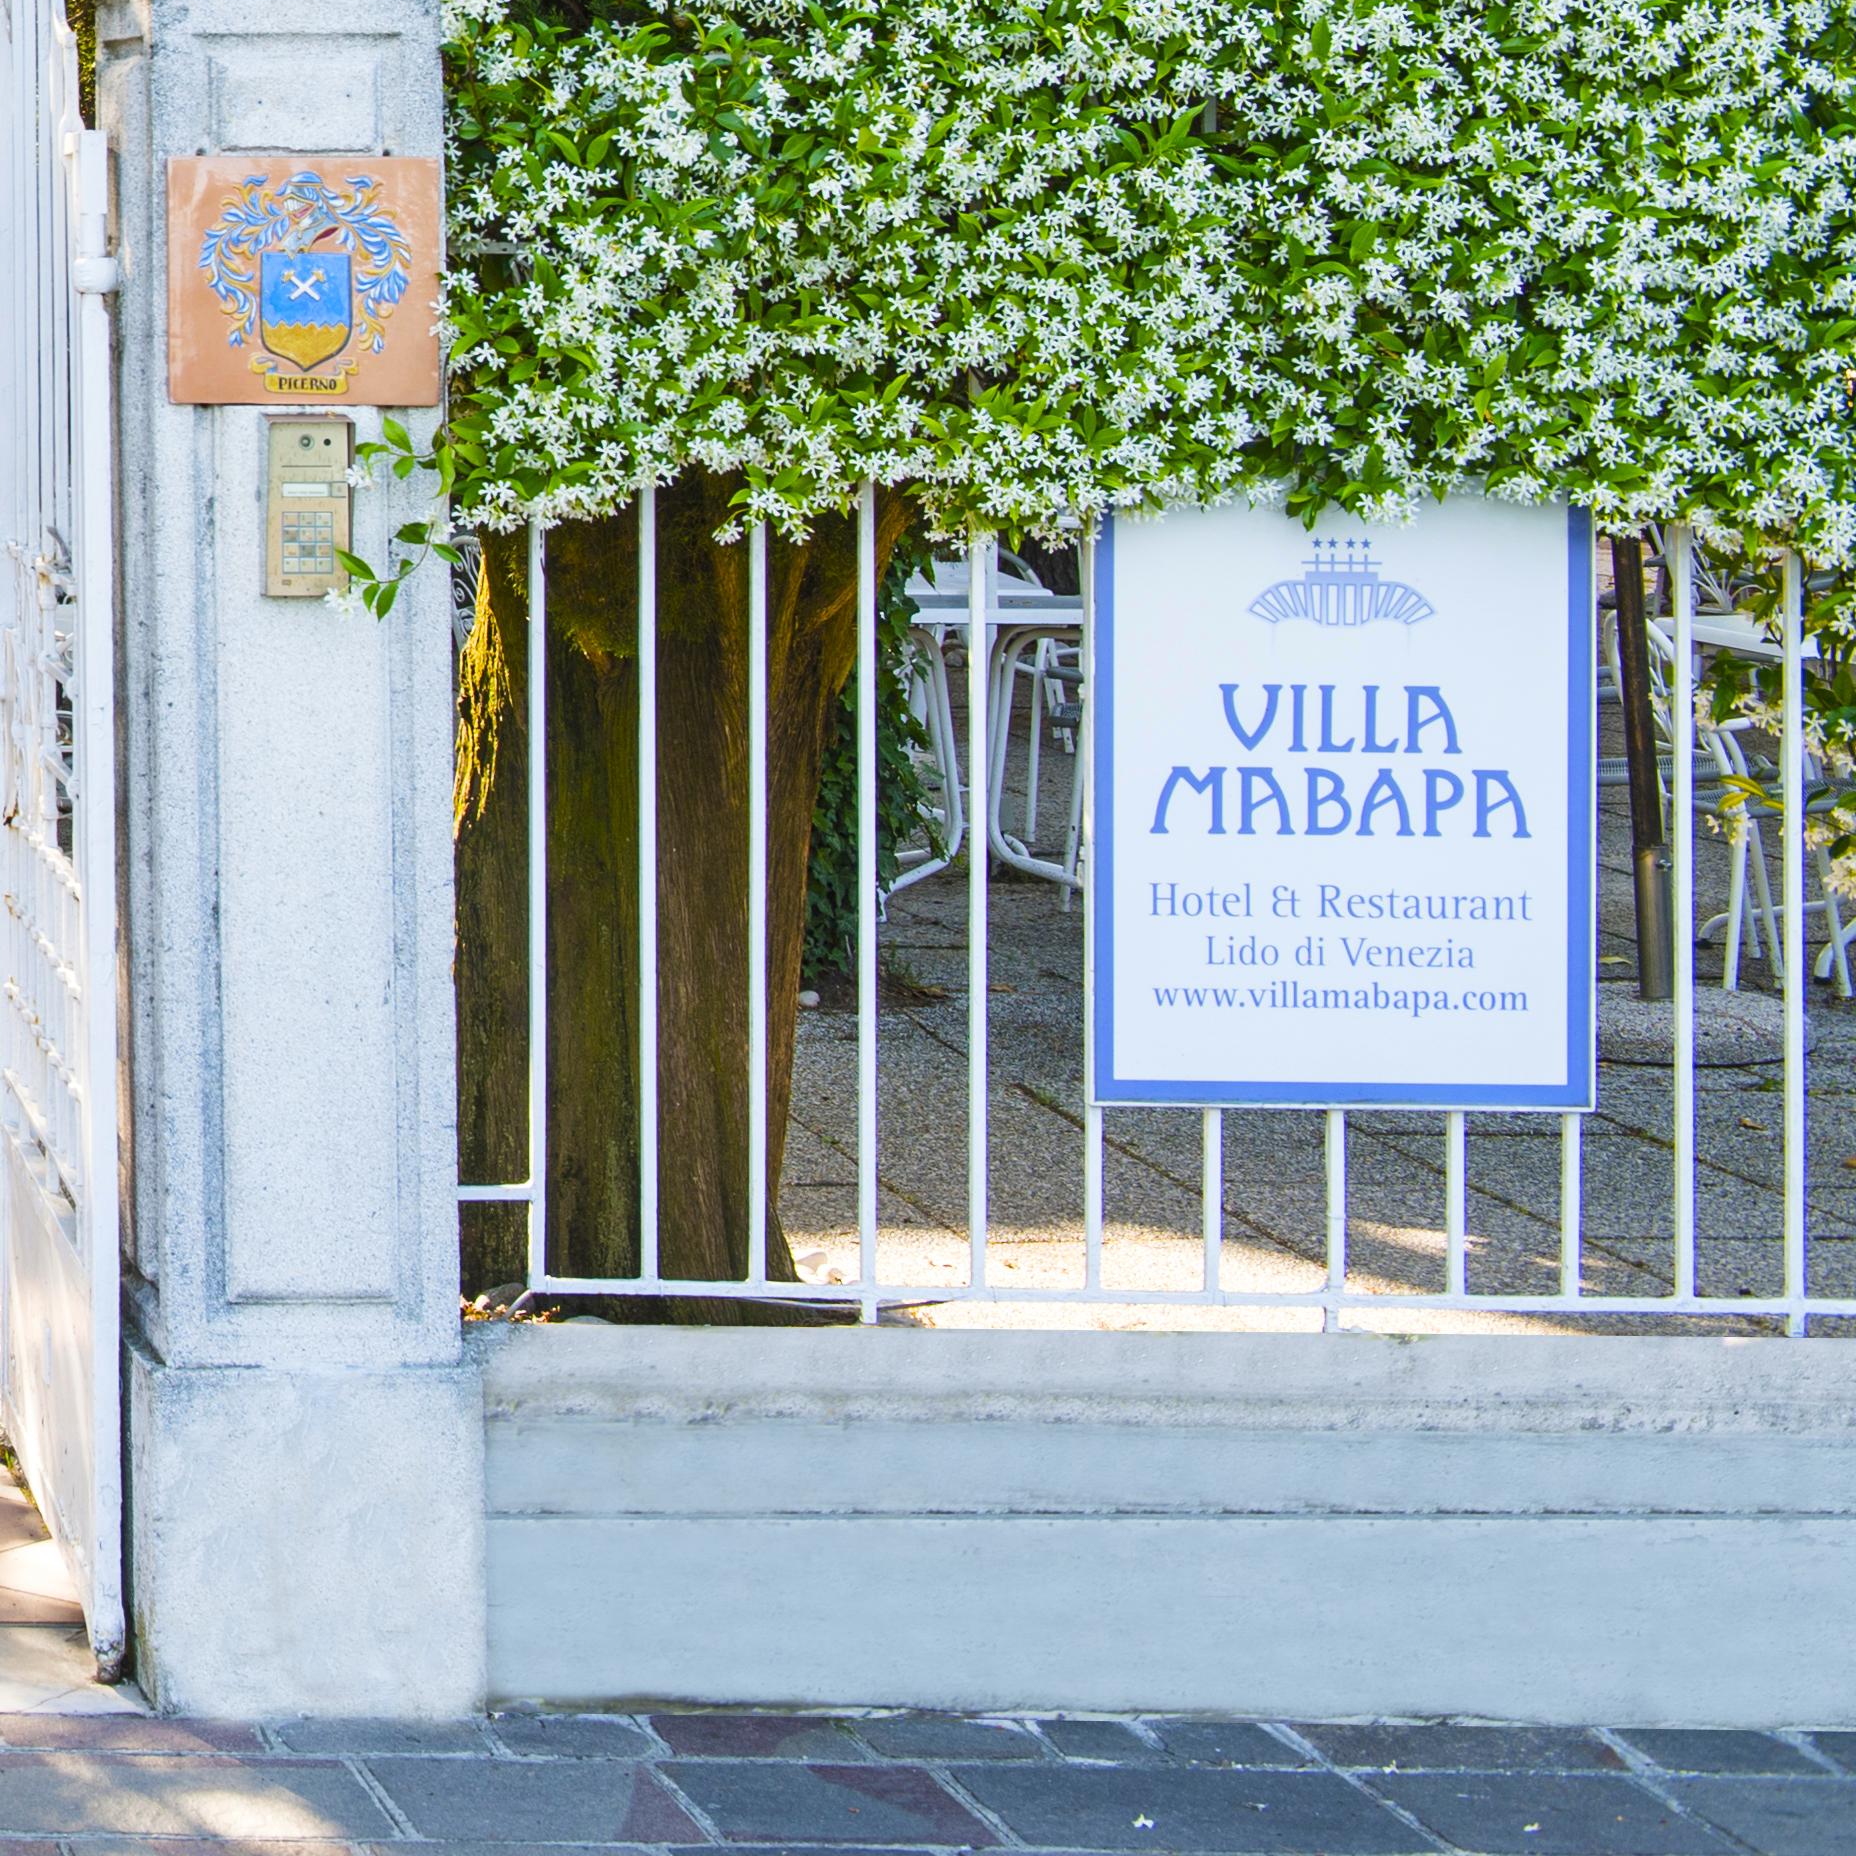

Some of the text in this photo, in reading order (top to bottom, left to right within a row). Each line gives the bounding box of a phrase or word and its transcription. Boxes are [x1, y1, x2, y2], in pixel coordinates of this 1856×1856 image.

[278, 376, 337, 391] PICERNO
[1218, 683, 1463, 755] VILLA
[1149, 765, 1533, 839] MABAPA
[1149, 882, 1533, 922] Hotel & Restaurant
[1205, 935, 1475, 970] Lido di Venezia
[1152, 980, 1529, 1019] www.villamabapa.com
